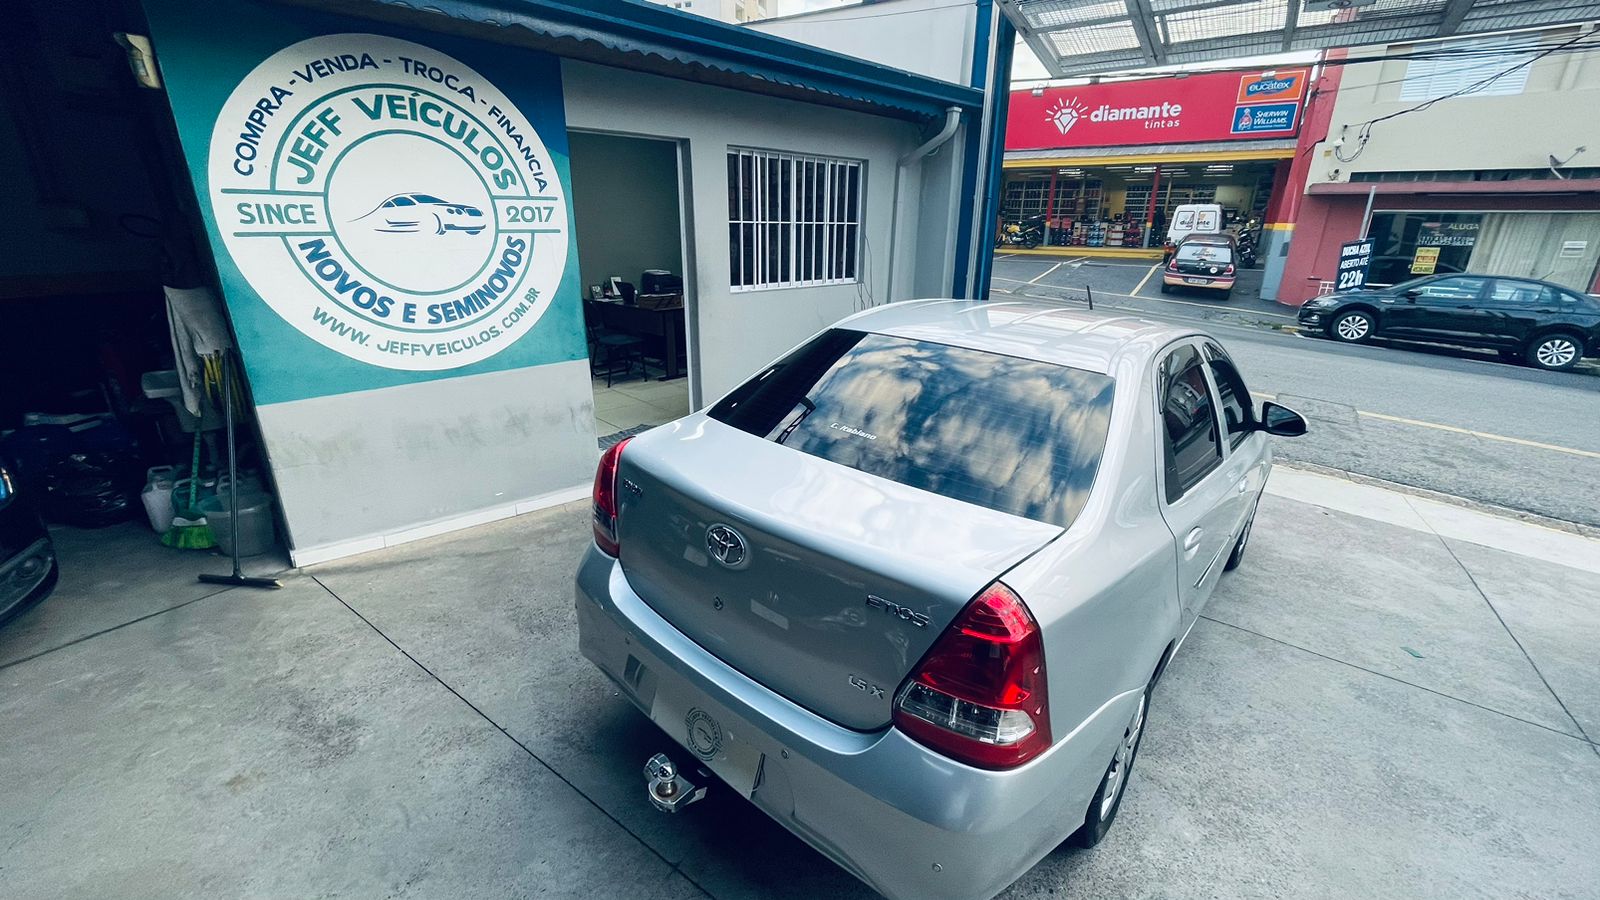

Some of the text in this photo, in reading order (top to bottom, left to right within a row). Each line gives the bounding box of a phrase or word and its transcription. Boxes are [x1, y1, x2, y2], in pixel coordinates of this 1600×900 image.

[1248, 81, 1290, 92] eucatex
[1090, 101, 1182, 122] diamante
[233, 85, 294, 177] COMPRA
[292, 53, 380, 84] VENDA
[398, 56, 476, 104] TROCA
[487, 105, 548, 193] FINANCIA
[1144, 119, 1180, 129] tintas
[287, 92, 517, 190] JEFF VEÍCULOS
[236, 202, 317, 225] SINCE
[505, 205, 555, 223] 2017
[297, 235, 526, 325] NOVOS E SEMINOVOS
[1338, 269, 1364, 289] 22h
[312, 306, 369, 347] WWW.
